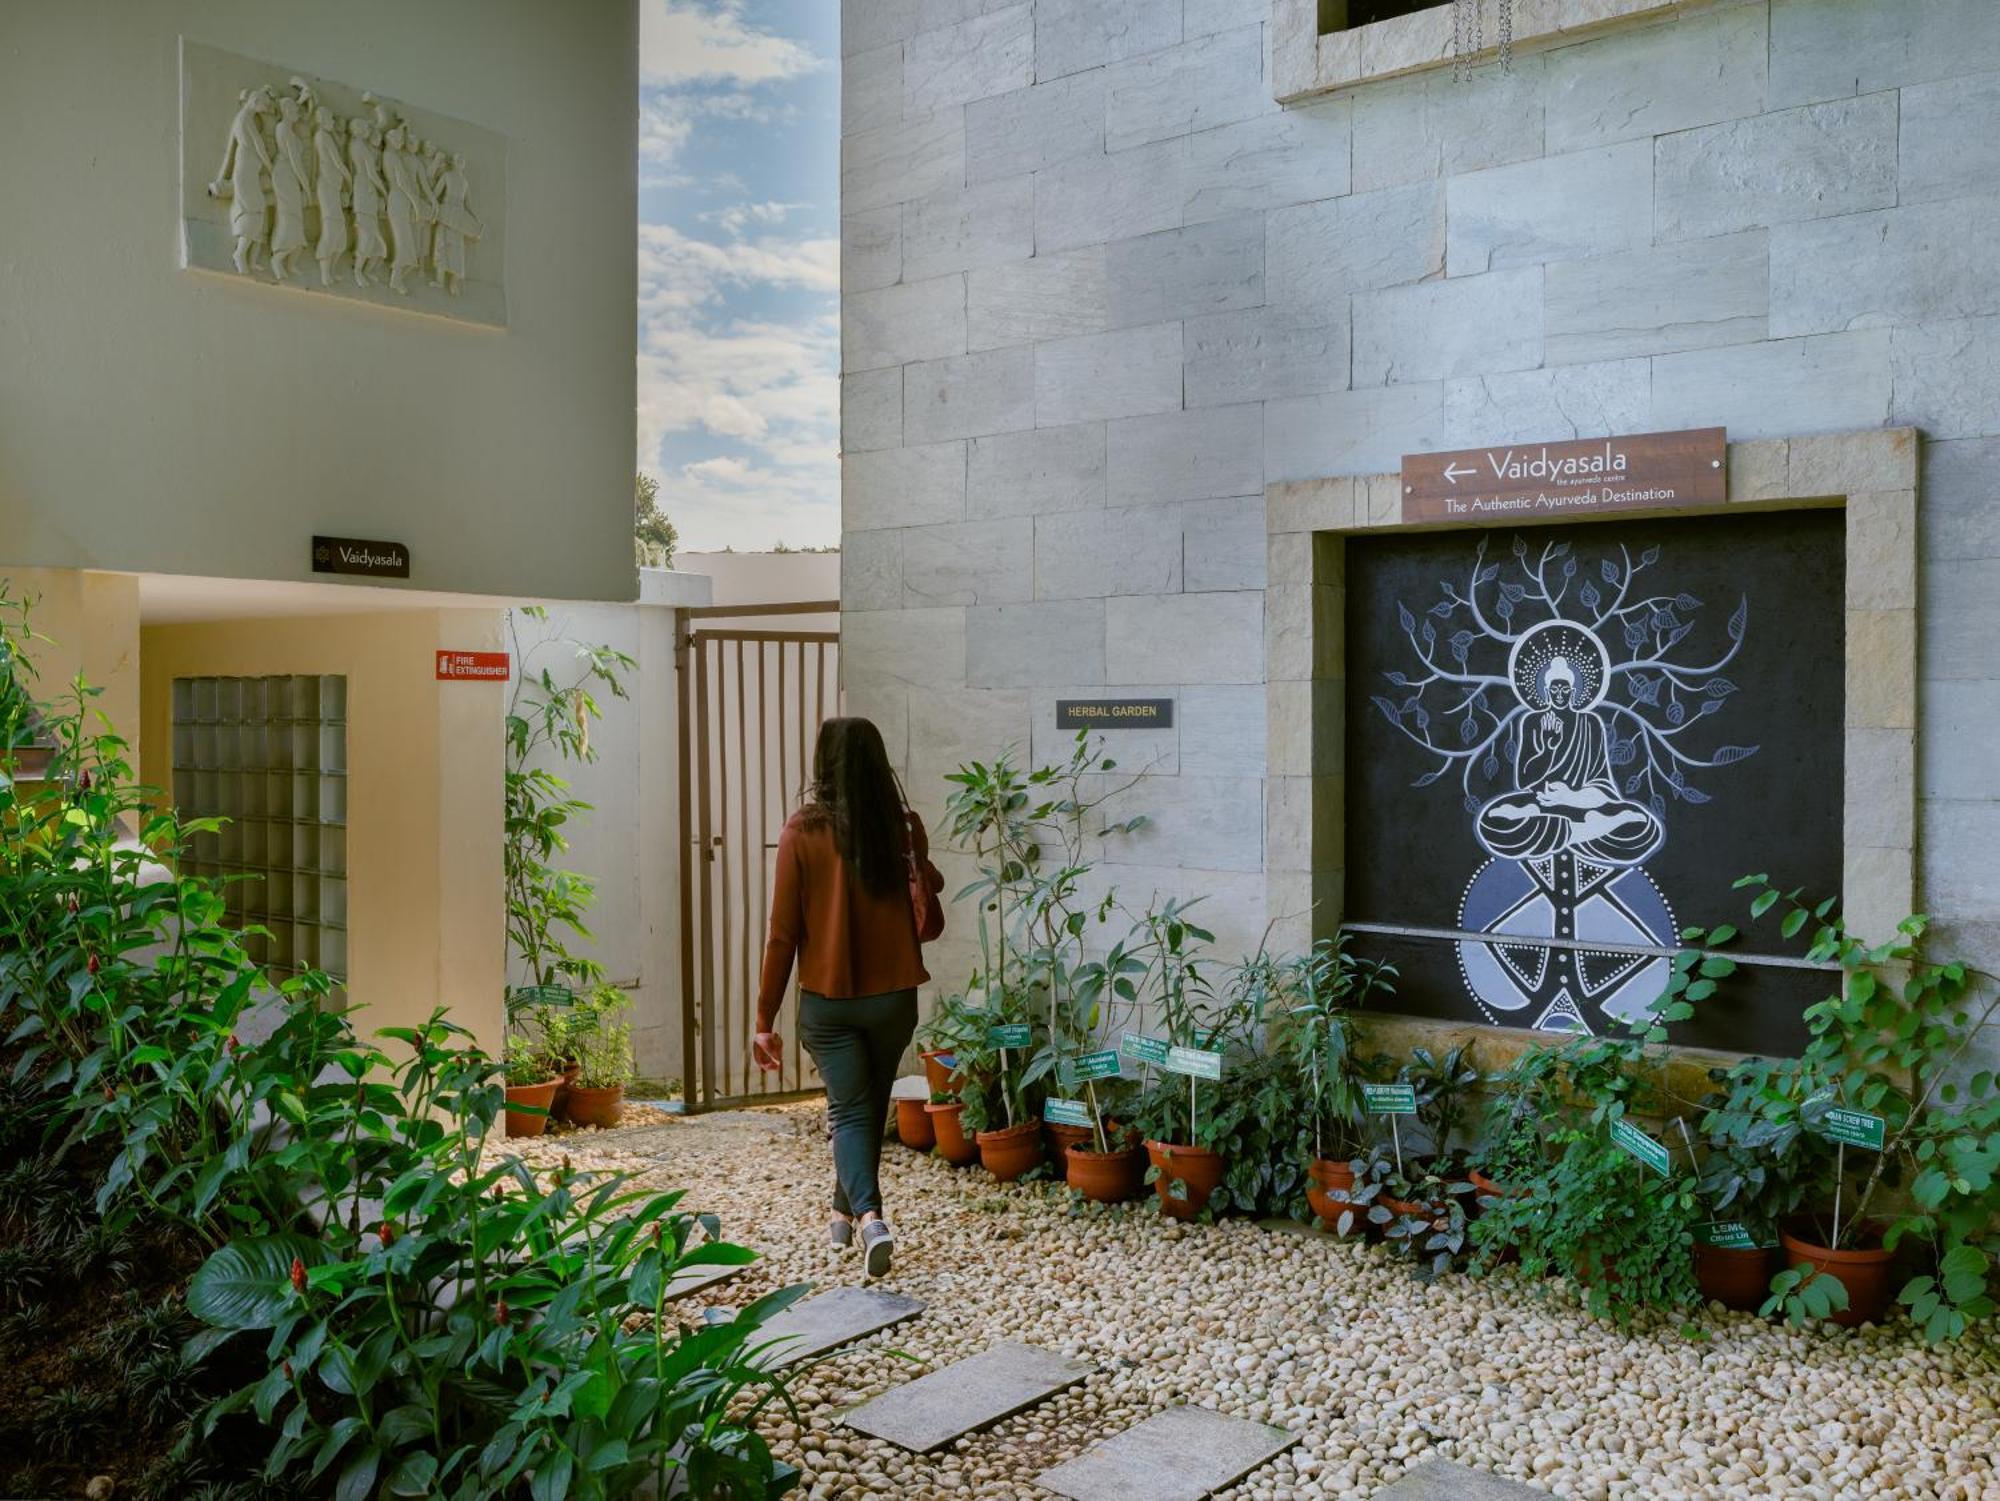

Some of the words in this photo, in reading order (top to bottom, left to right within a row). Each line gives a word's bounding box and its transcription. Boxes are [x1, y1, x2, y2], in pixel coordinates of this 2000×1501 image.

[1487, 442, 1627, 482] Vaidyasala
[1570, 475, 1601, 486] ayurveda
[1444, 499, 1468, 513] The
[1471, 494, 1532, 512] Authentic
[1536, 488, 1598, 509] Ayurveda
[1602, 486, 1675, 503] Destination
[339, 545, 403, 568] Vaidyasala
[456, 656, 475, 666] FIRE
[456, 665, 507, 676] EXTINGUISHER
[1068, 706, 1110, 717] HERBAL
[1112, 705, 1157, 717] GARDEN
[1861, 1117, 1874, 1129] TREE
